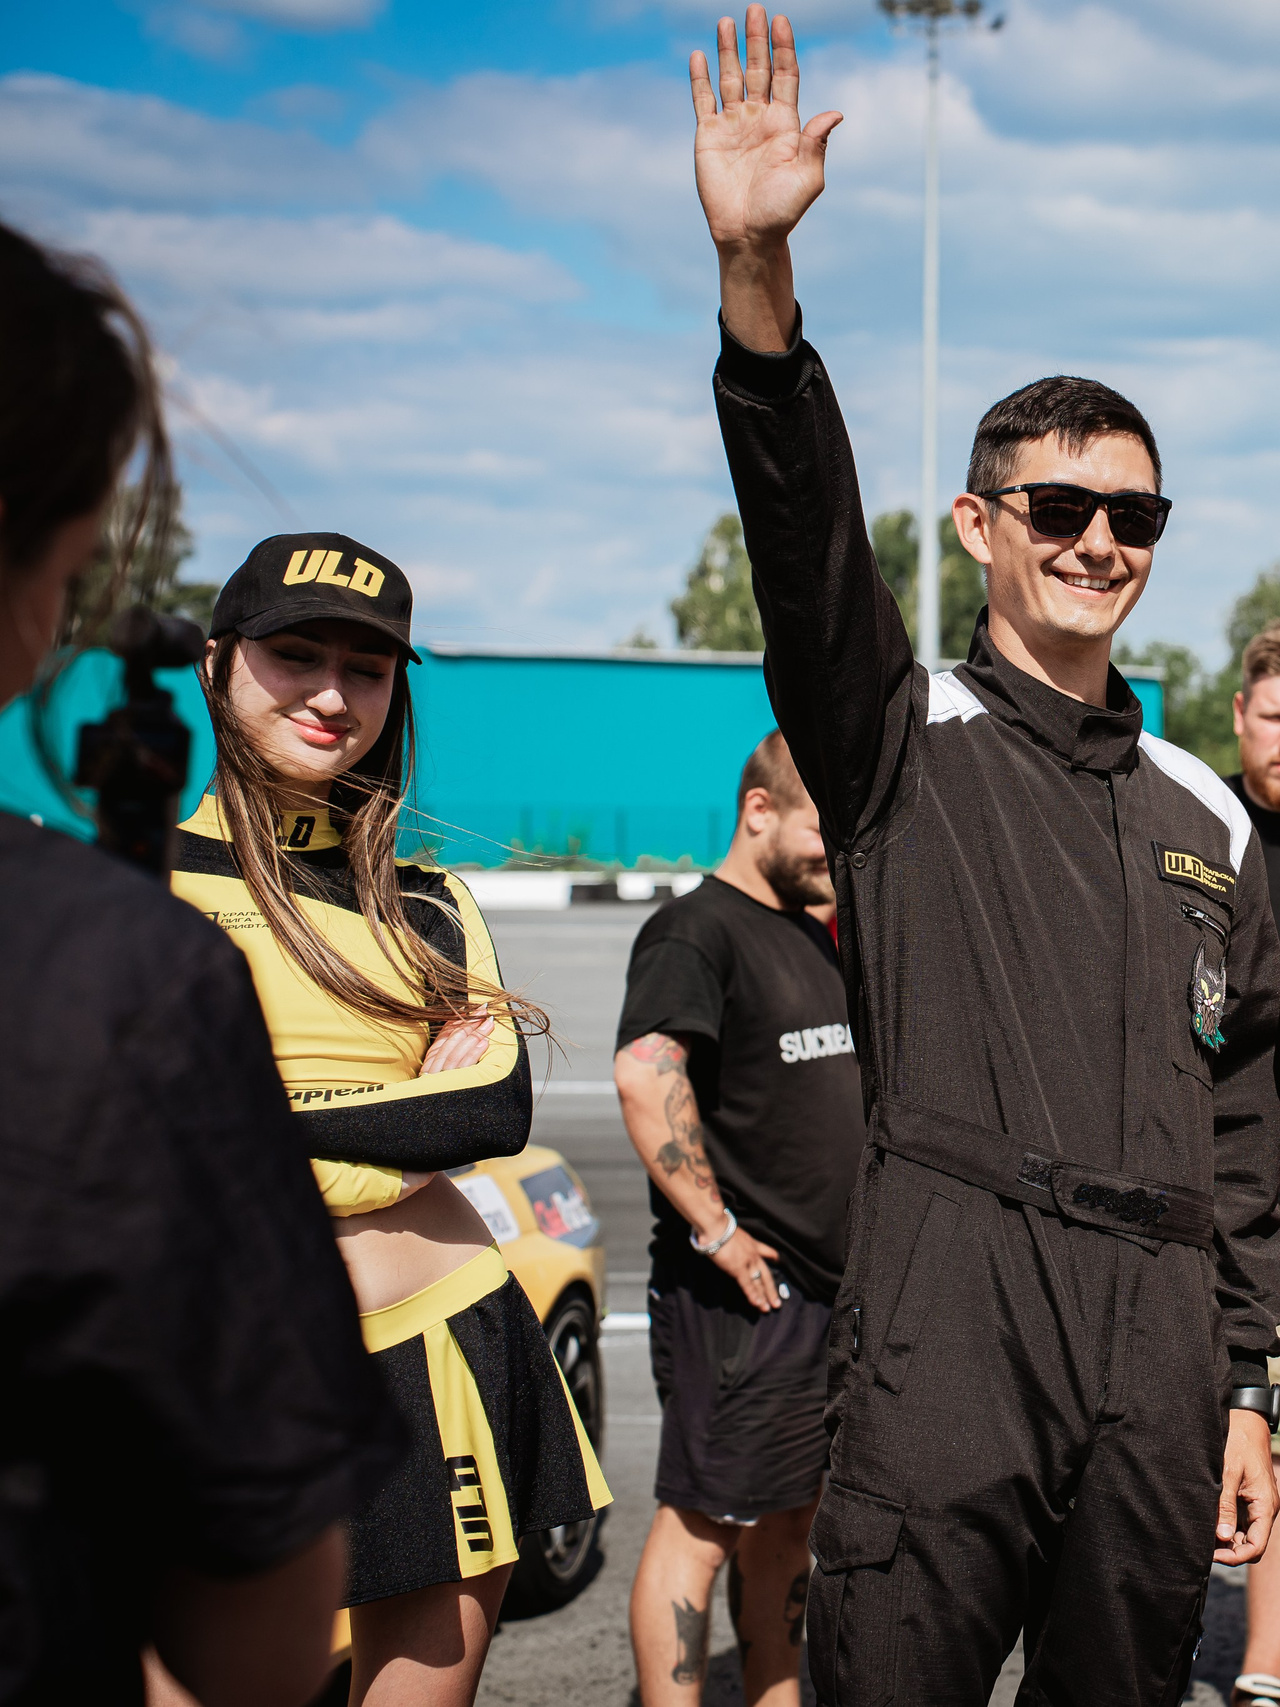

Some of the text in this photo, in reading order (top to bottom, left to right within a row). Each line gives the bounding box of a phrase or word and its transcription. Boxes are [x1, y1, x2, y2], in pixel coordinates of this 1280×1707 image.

[282, 549, 386, 598] ULD
[1168, 854, 1202, 879] ULD
[446, 1454, 495, 1553] ULD
